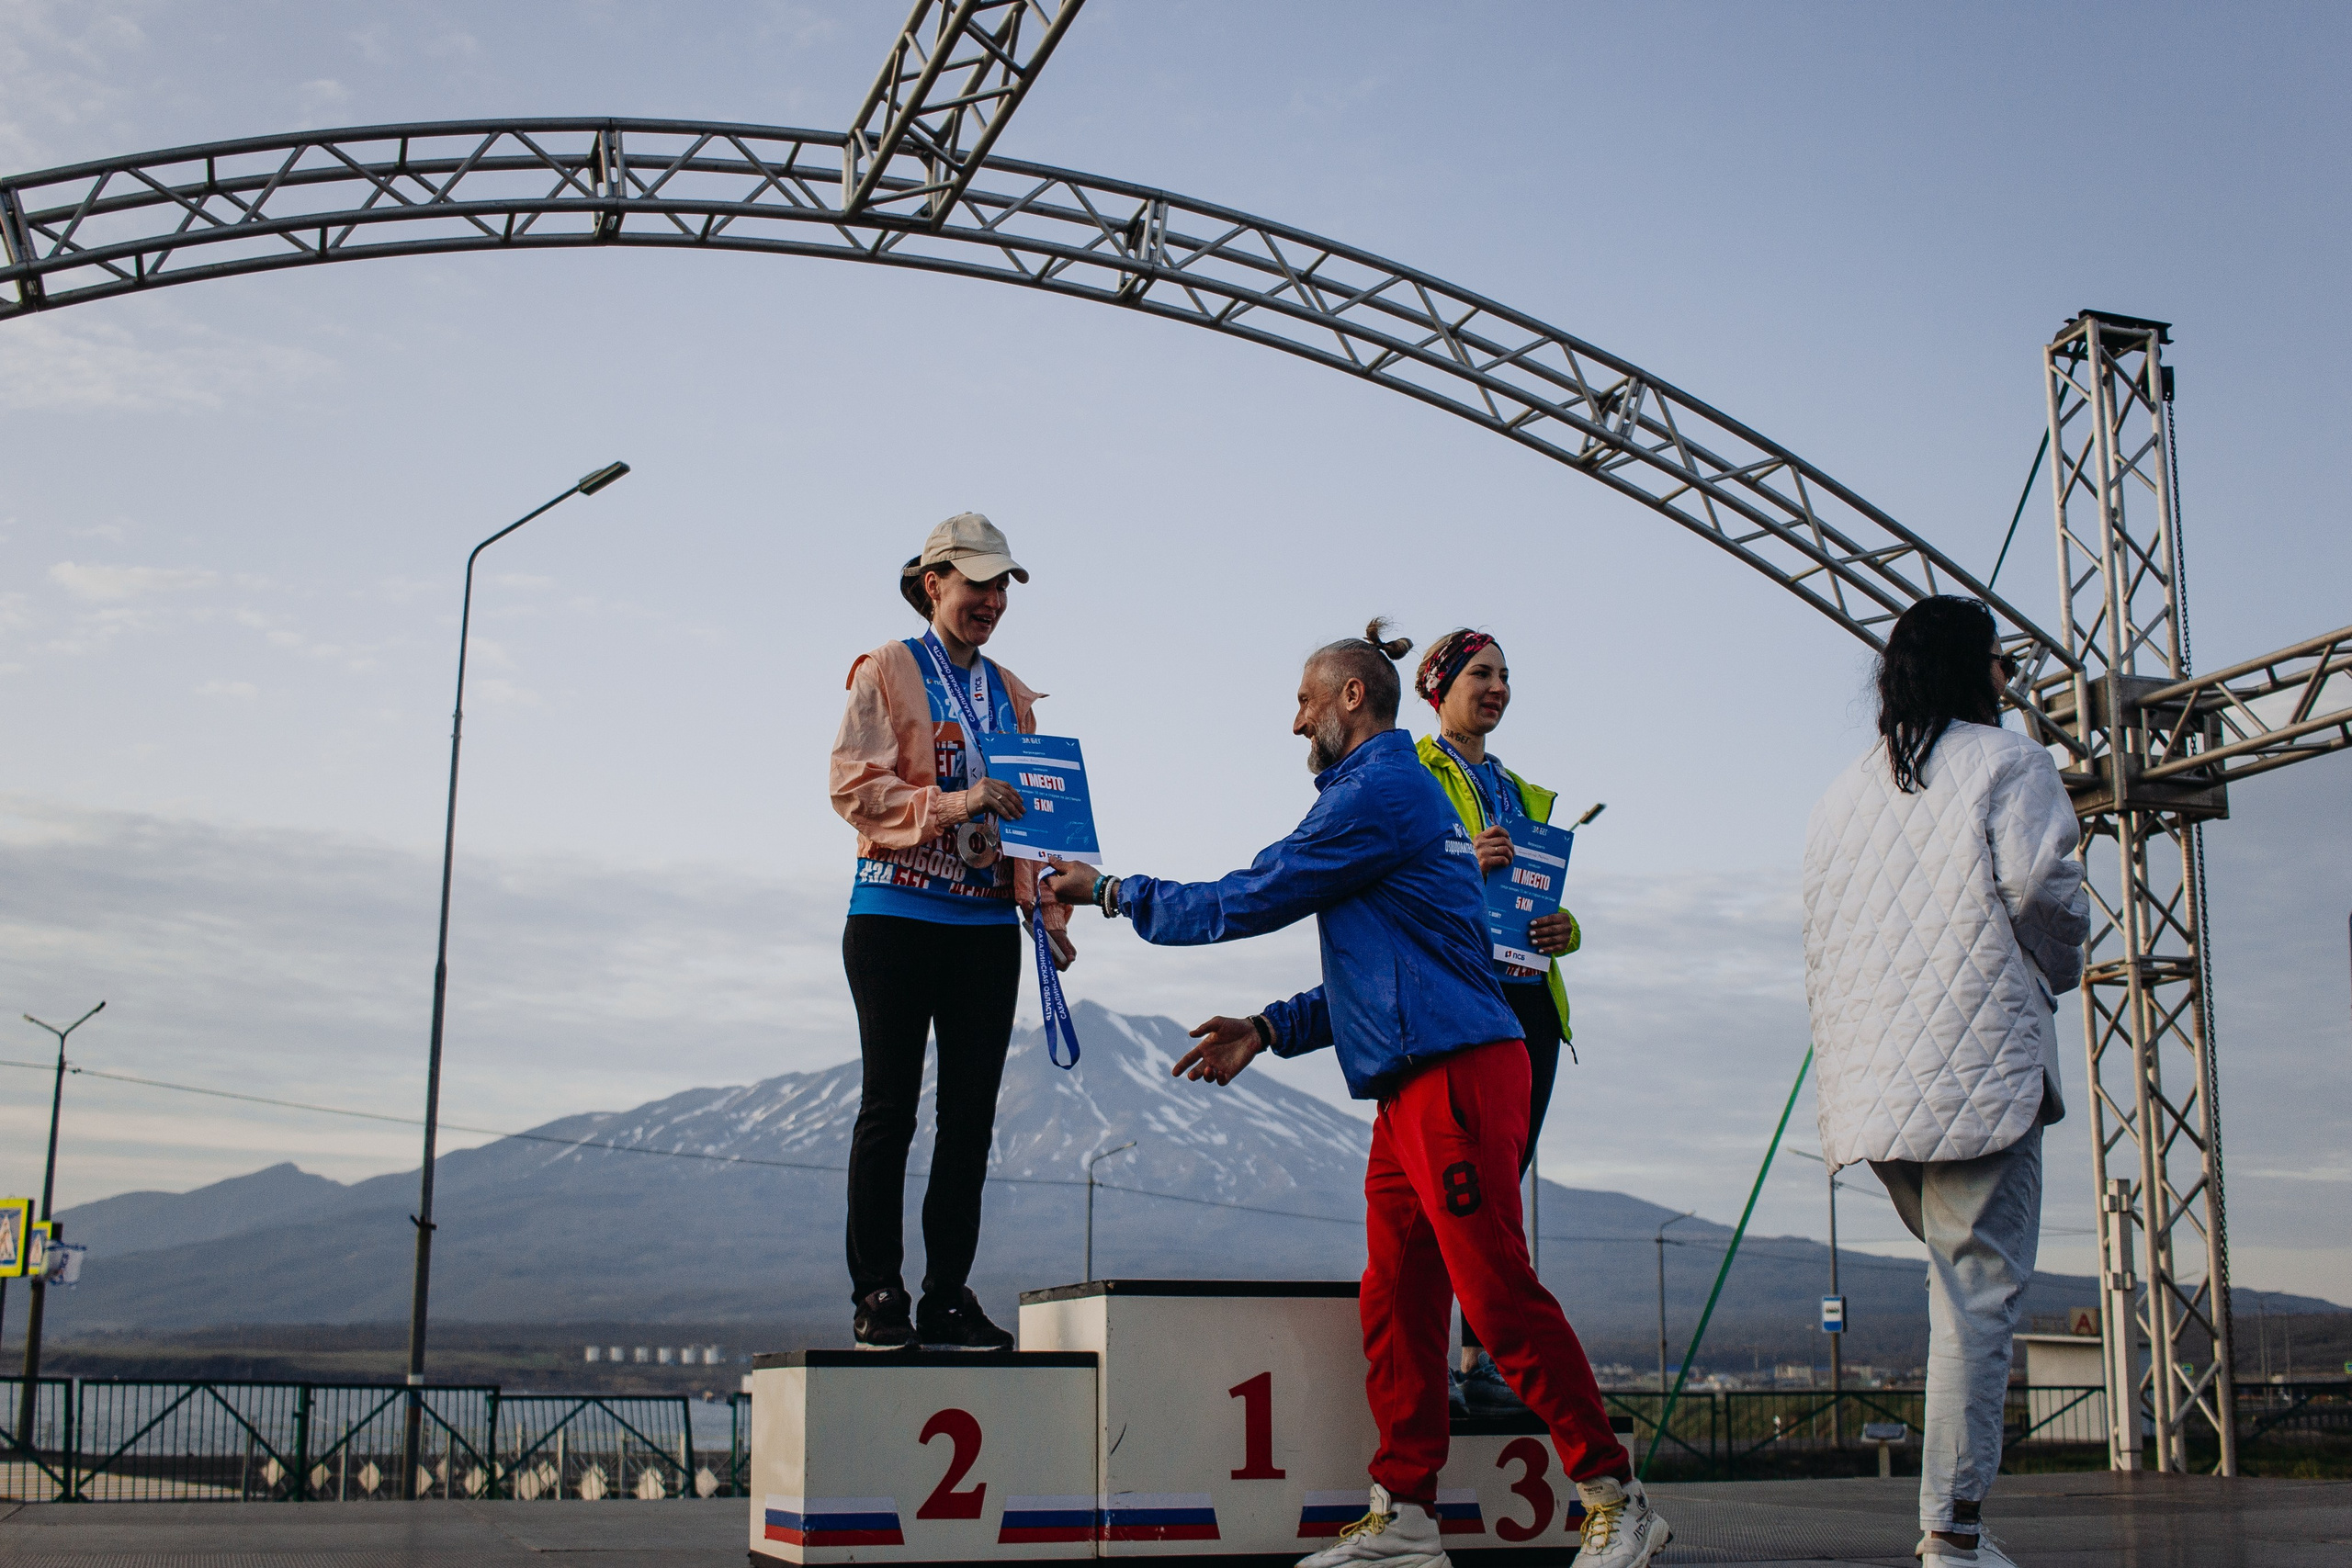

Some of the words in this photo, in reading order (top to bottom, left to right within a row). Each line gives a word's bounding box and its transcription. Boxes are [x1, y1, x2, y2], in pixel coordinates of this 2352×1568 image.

[933, 645, 952, 674] ОБЛАСТЬ
[948, 674, 976, 722] САХАЛИНСКАЯ
[974, 676, 983, 692] ПСБ
[1028, 773, 1066, 792] МЕСТО
[1034, 797, 1040, 811] 5
[1040, 799, 1055, 813] КМ
[1511, 866, 1523, 885] III
[1521, 869, 1551, 892] МЕСТО
[1515, 896, 1522, 909] 5
[1521, 897, 1534, 913] КМ
[1512, 953, 1525, 961] ПСБ
[1036, 928, 1049, 985] САХАЛИНСКАЯ
[1043, 985, 1053, 1021] ОБЛАСТЬ
[1442, 1160, 1482, 1218] 8
[1227, 1371, 1287, 1480] 1
[916, 1408, 988, 1519] 2
[1495, 1437, 1555, 1542] 3
